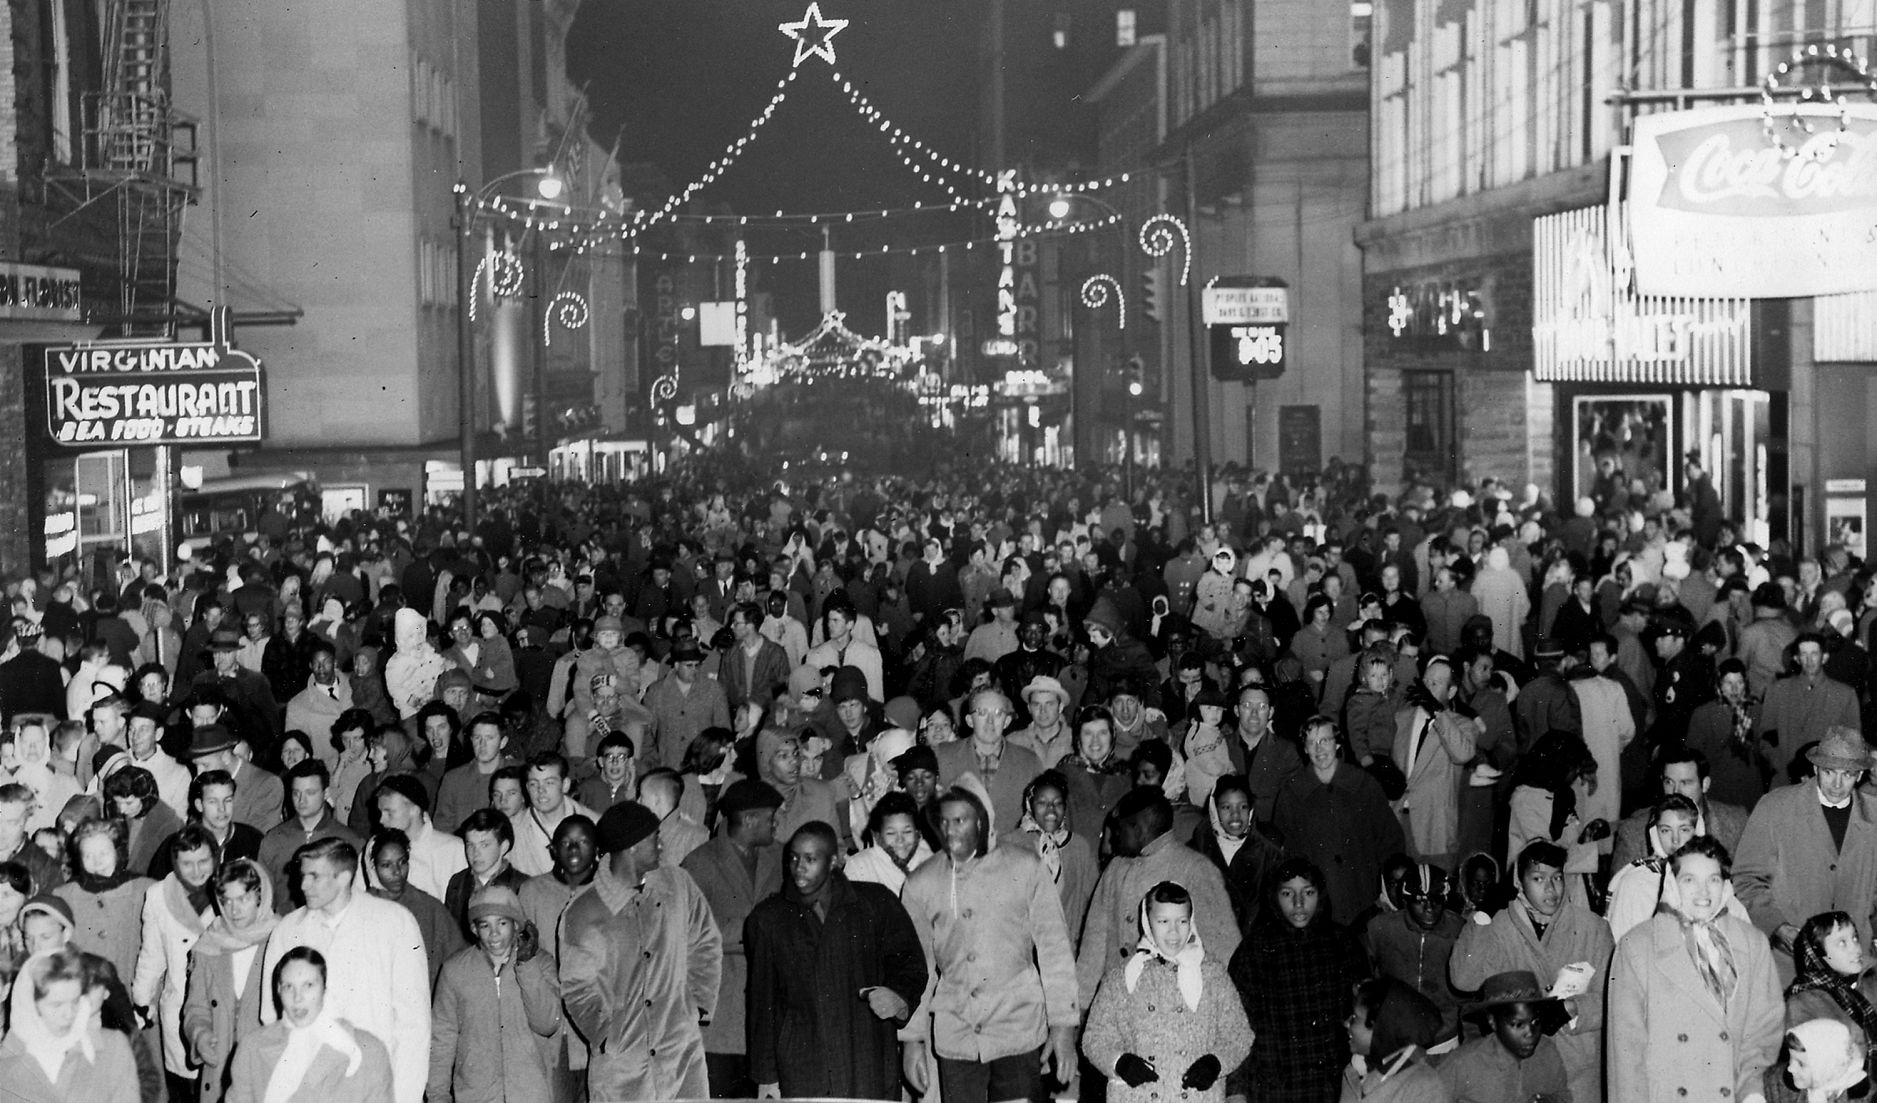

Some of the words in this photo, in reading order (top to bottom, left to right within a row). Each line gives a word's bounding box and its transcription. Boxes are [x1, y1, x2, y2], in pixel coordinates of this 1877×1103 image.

[58, 347, 219, 373] VIRGINIAN
[51, 377, 256, 419] RESTAURANT
[111, 415, 165, 440] FOOD
[175, 415, 255, 438] STEAKS
